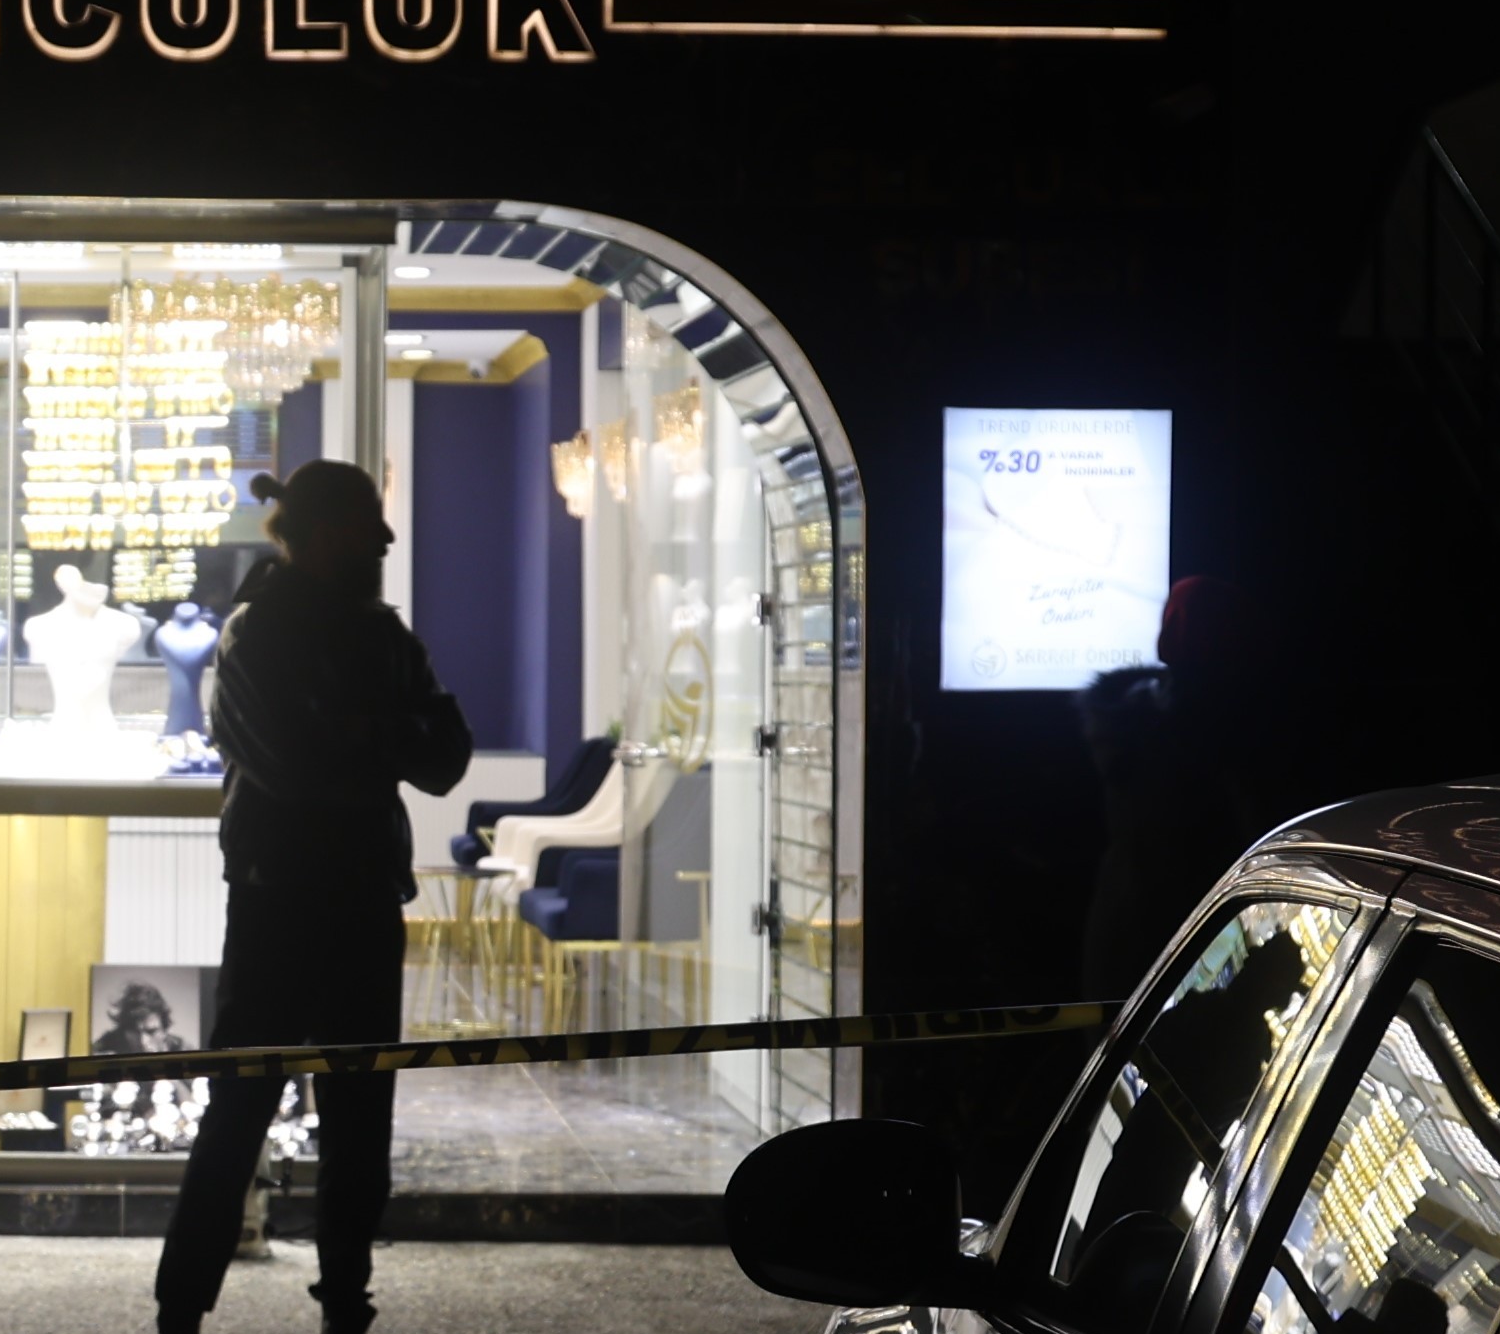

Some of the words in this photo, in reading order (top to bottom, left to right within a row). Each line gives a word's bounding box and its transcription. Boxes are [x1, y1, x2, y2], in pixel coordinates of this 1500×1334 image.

[977, 418, 1031, 434] TREND
[978, 448, 1042, 474] %30
[1060, 450, 1104, 460] VARAN
[1015, 649, 1076, 665] SARRAF
